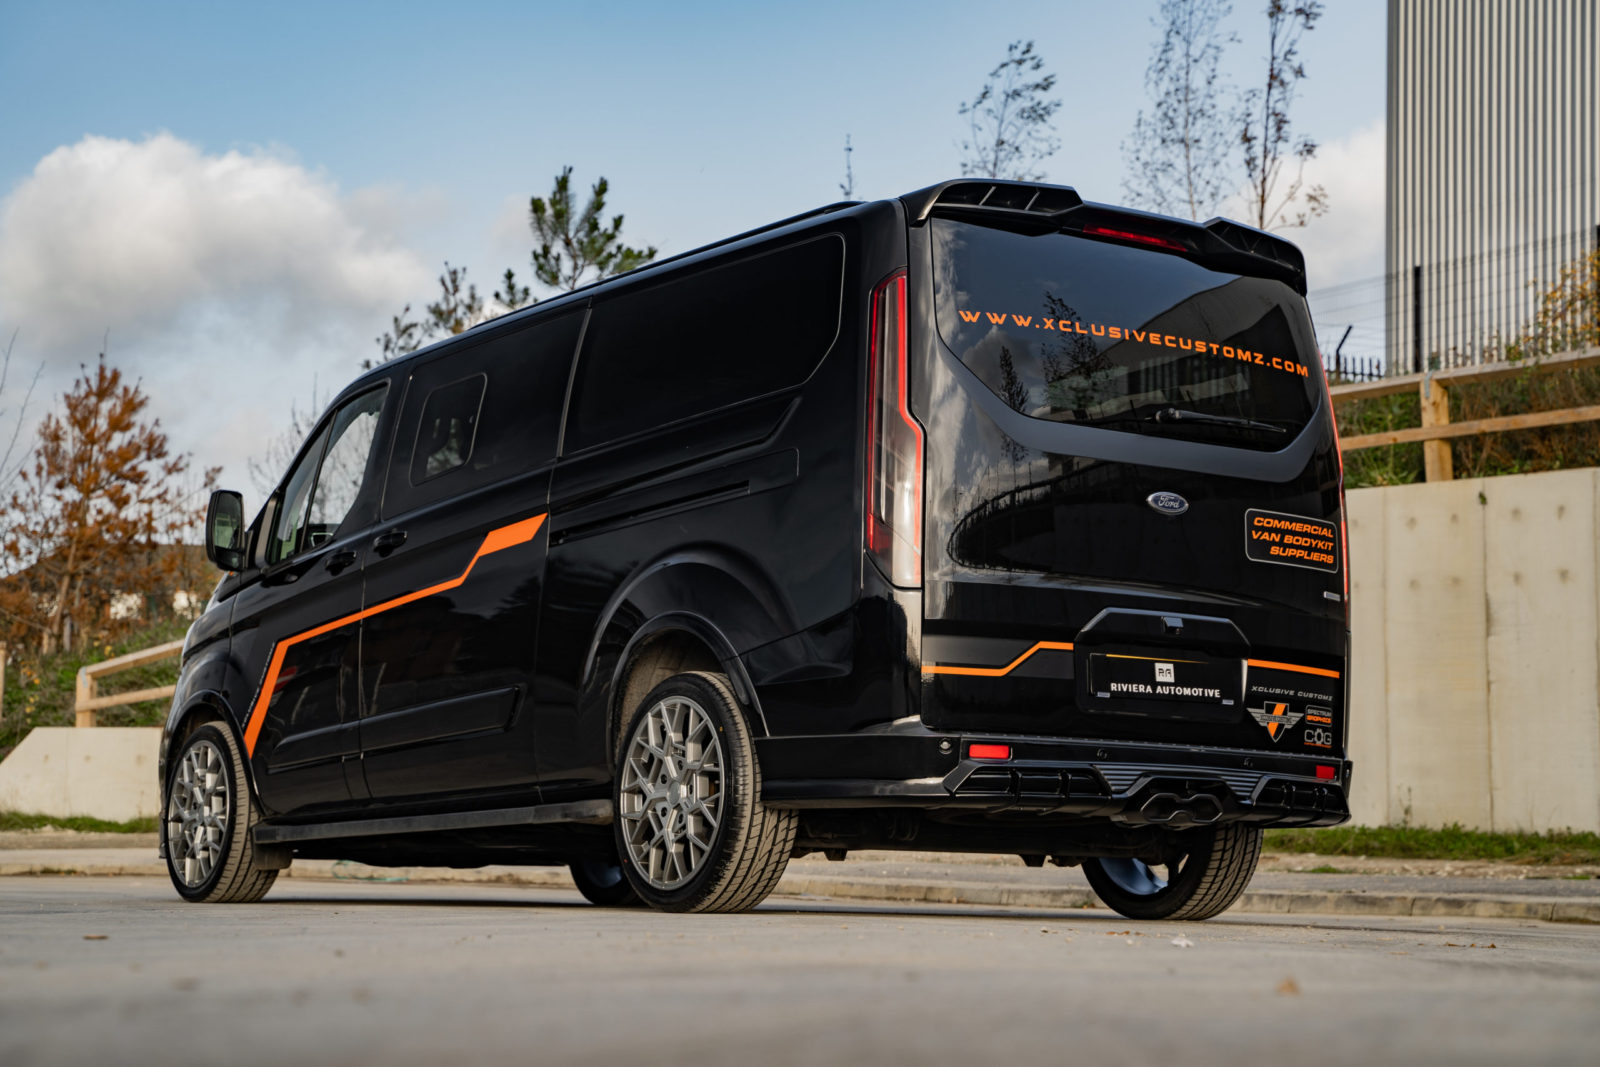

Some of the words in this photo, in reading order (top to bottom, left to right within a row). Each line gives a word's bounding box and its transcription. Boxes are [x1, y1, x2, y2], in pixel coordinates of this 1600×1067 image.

[958, 309, 1309, 378] WWW.XCLUSIVECUSTOMZ.COM
[1253, 516, 1334, 538] COMMERCIAL
[1251, 530, 1281, 543] VAN
[1283, 535, 1334, 551] BODYKIT
[1269, 546, 1334, 564] SUPPLIERS
[1110, 682, 1153, 694] RIVIERA
[1156, 685, 1221, 698] AUTOMOTIVE
[1251, 685, 1295, 696] XCLUSIVE
